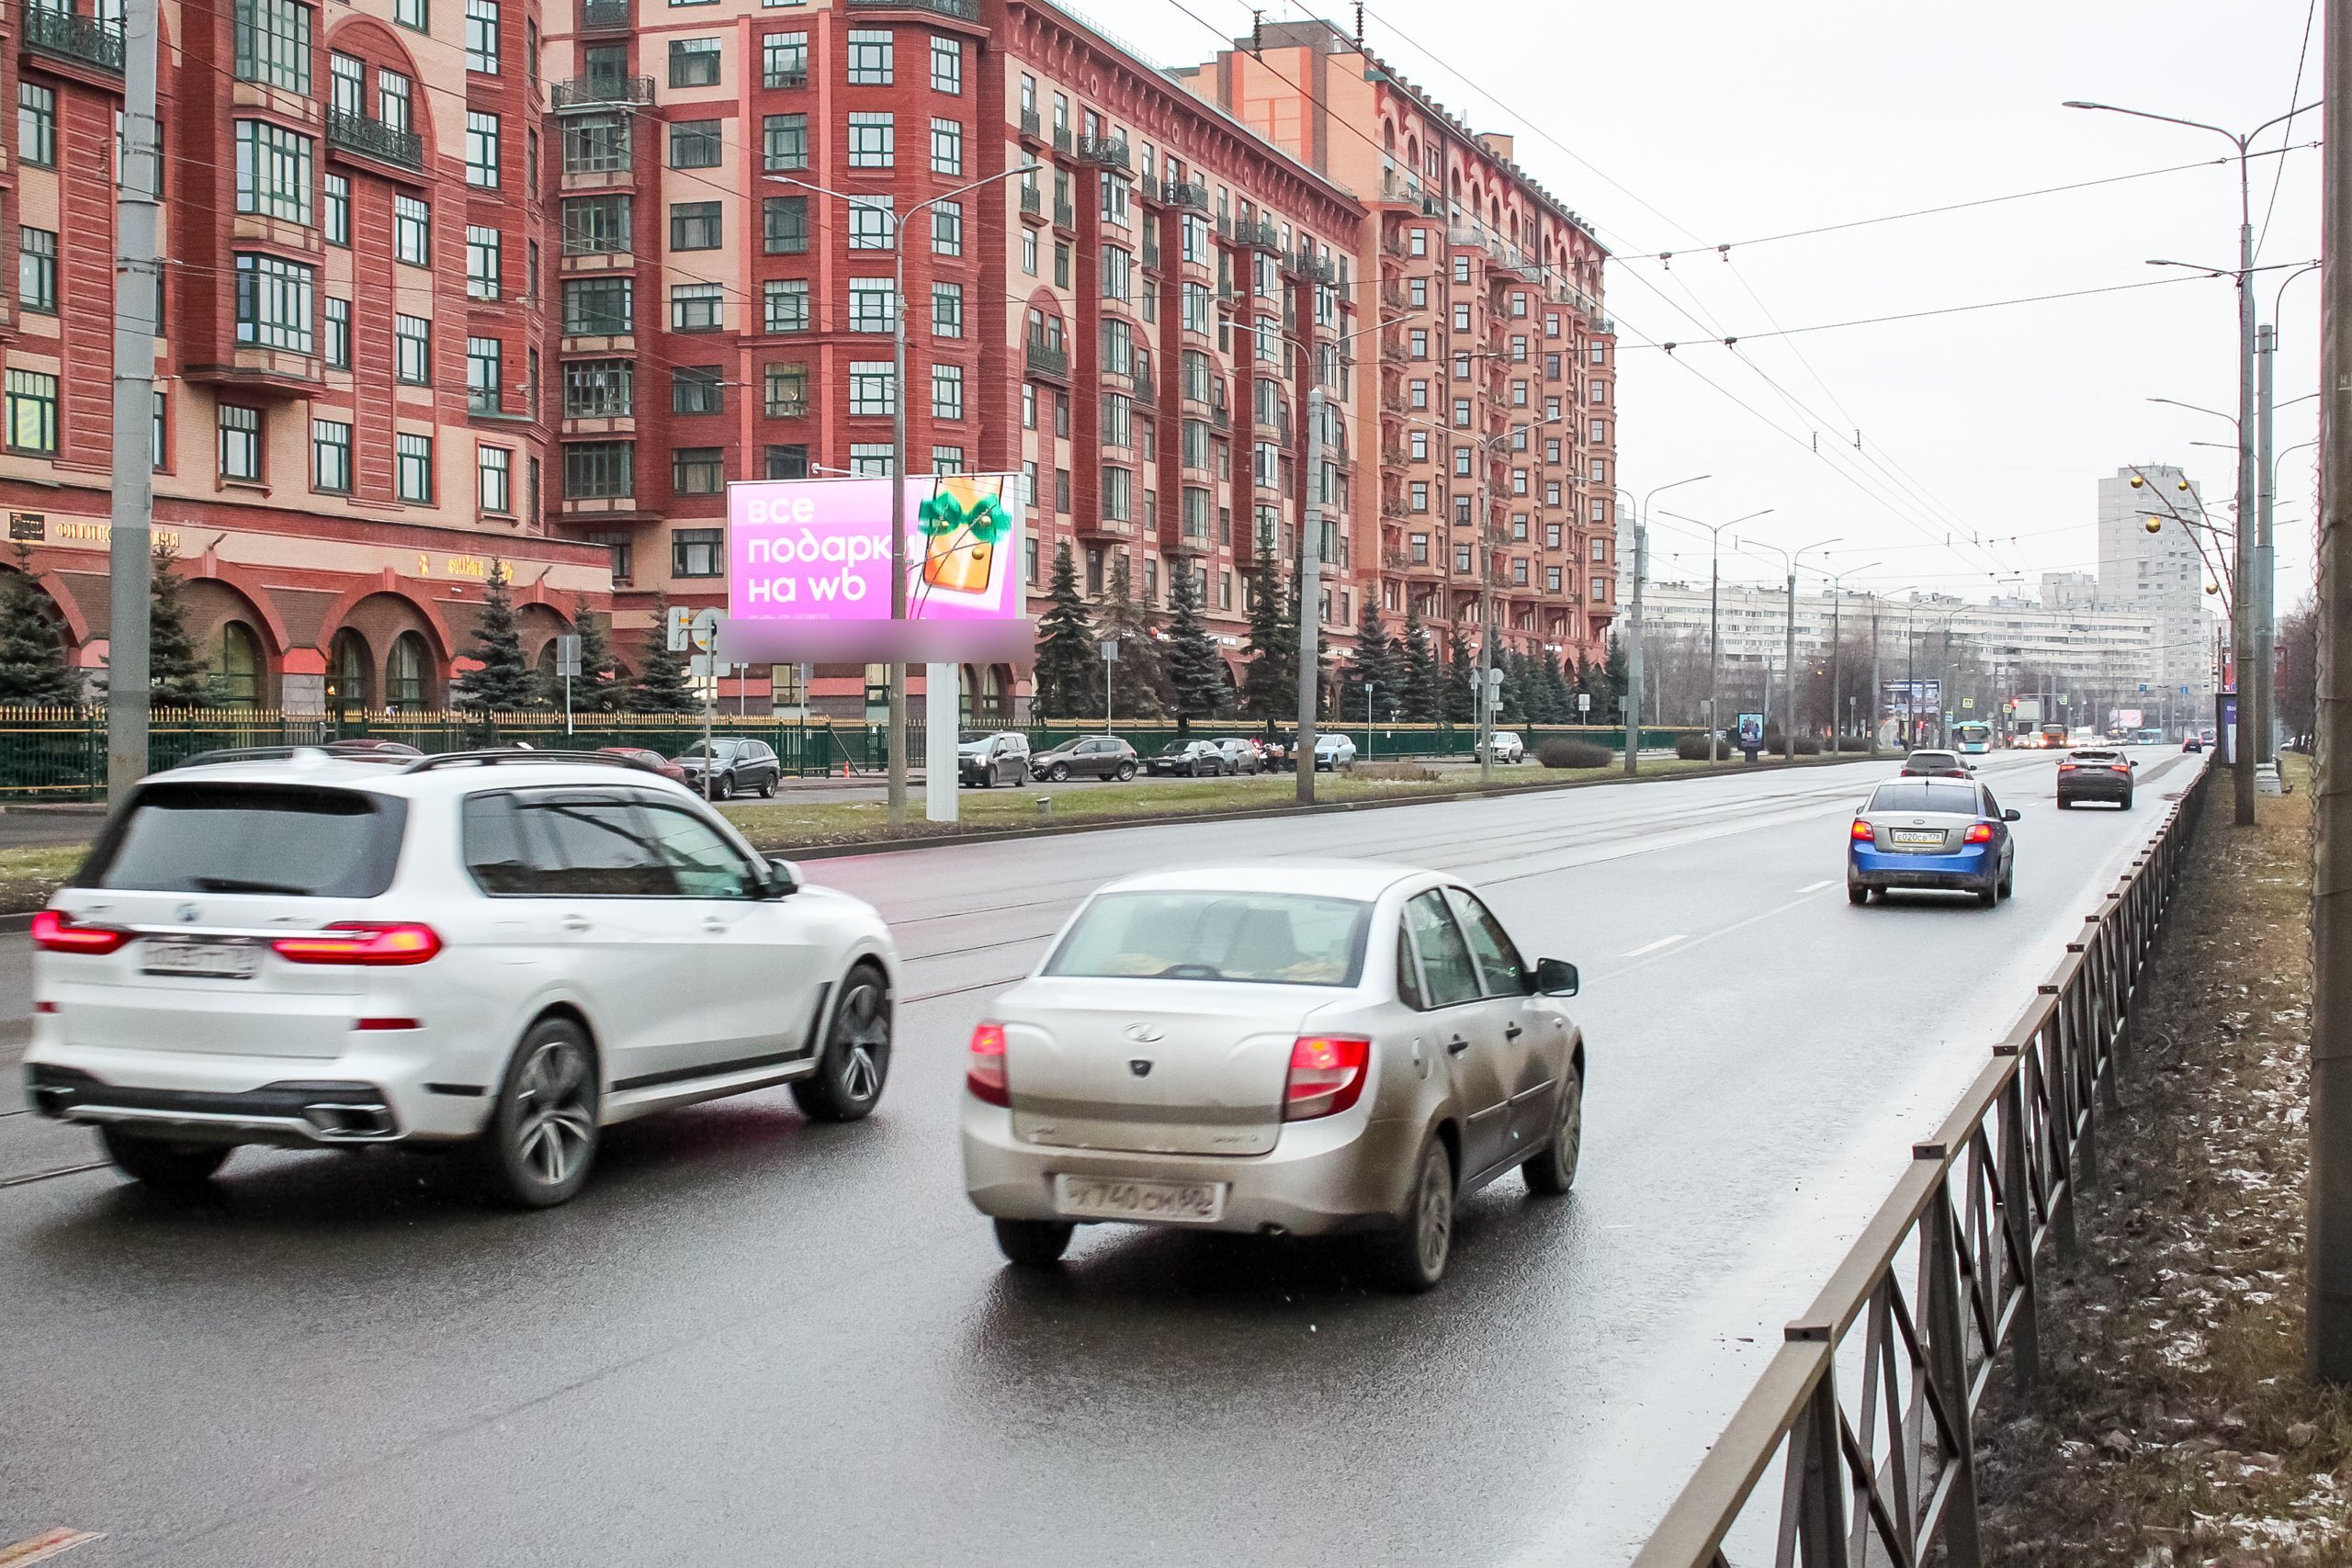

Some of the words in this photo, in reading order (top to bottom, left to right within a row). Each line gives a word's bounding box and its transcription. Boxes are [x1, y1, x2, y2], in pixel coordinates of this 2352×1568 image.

[748, 497, 815, 524] все
[749, 577, 796, 603] на
[808, 567, 866, 602] wb
